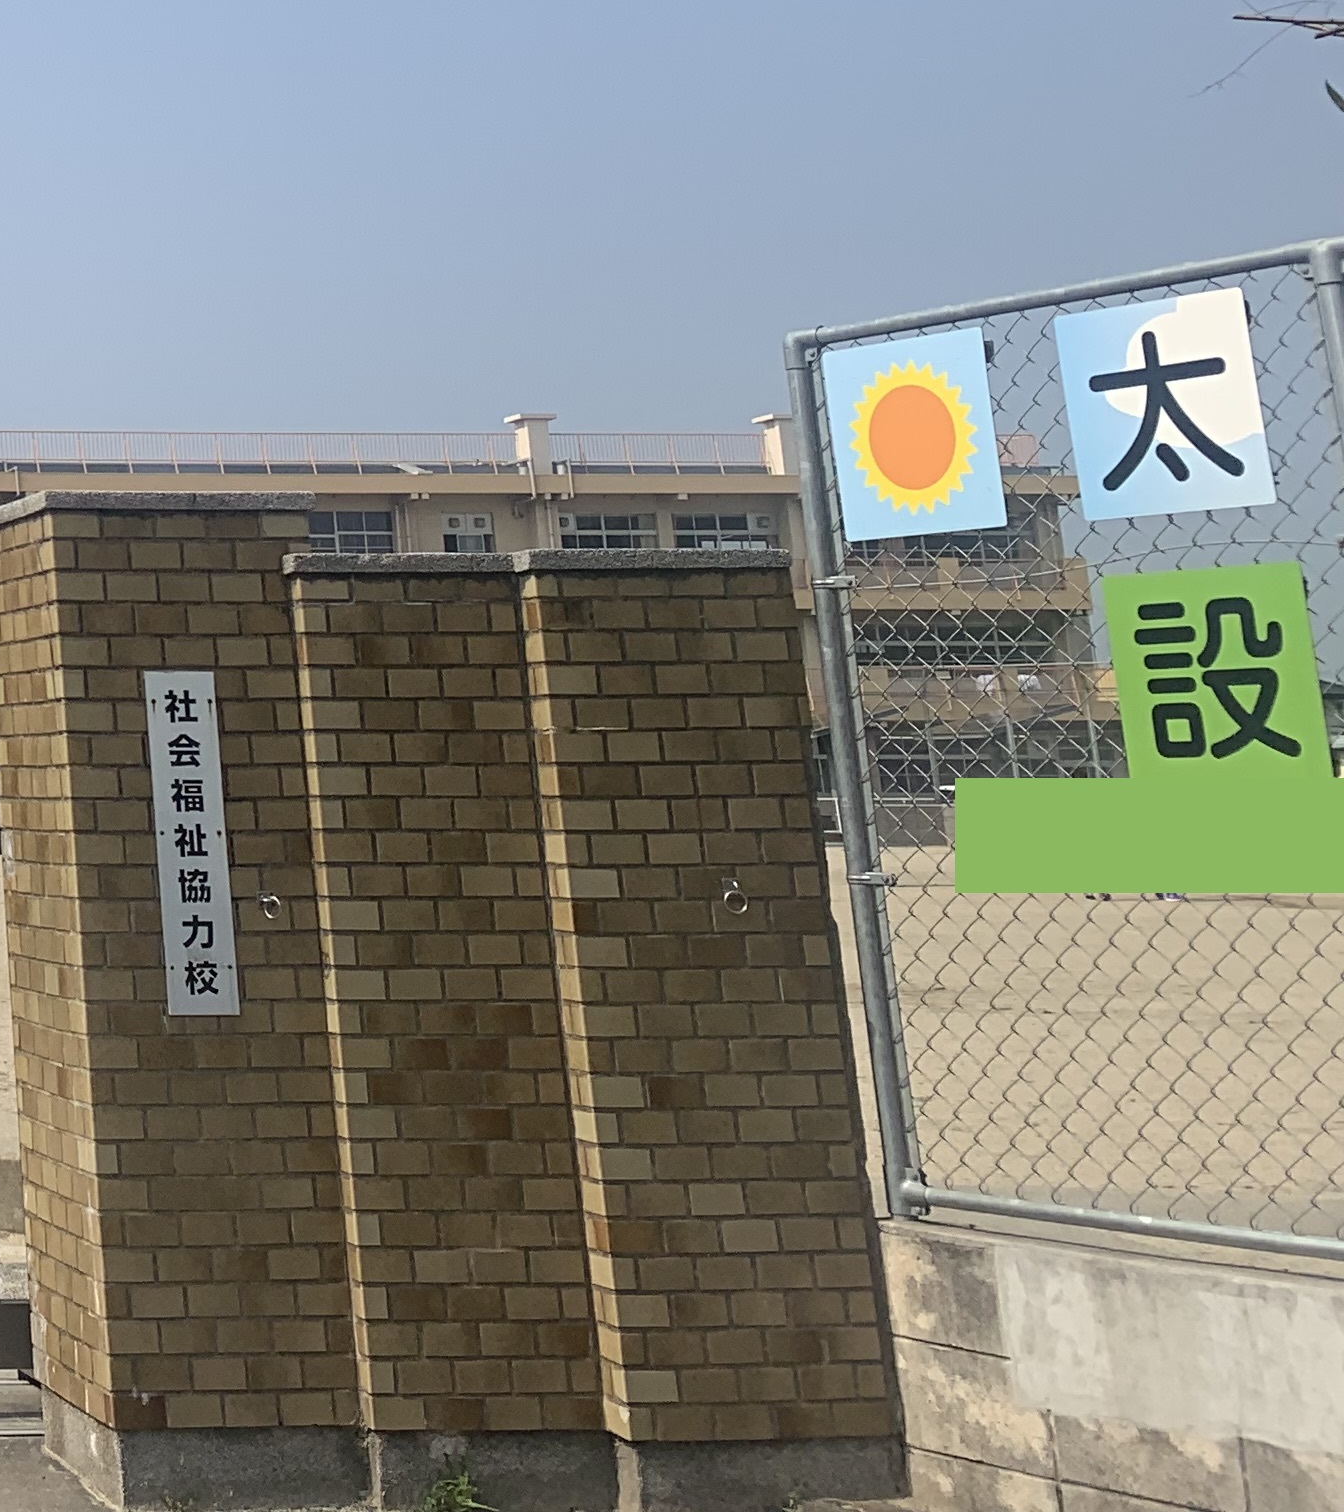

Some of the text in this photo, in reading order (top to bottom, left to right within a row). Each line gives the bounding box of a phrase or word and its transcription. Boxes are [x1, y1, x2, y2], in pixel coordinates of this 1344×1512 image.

[1089, 330, 1244, 492] 太
[1134, 597, 1302, 759] 設
[164, 690, 219, 996] 社会福祉協力校
